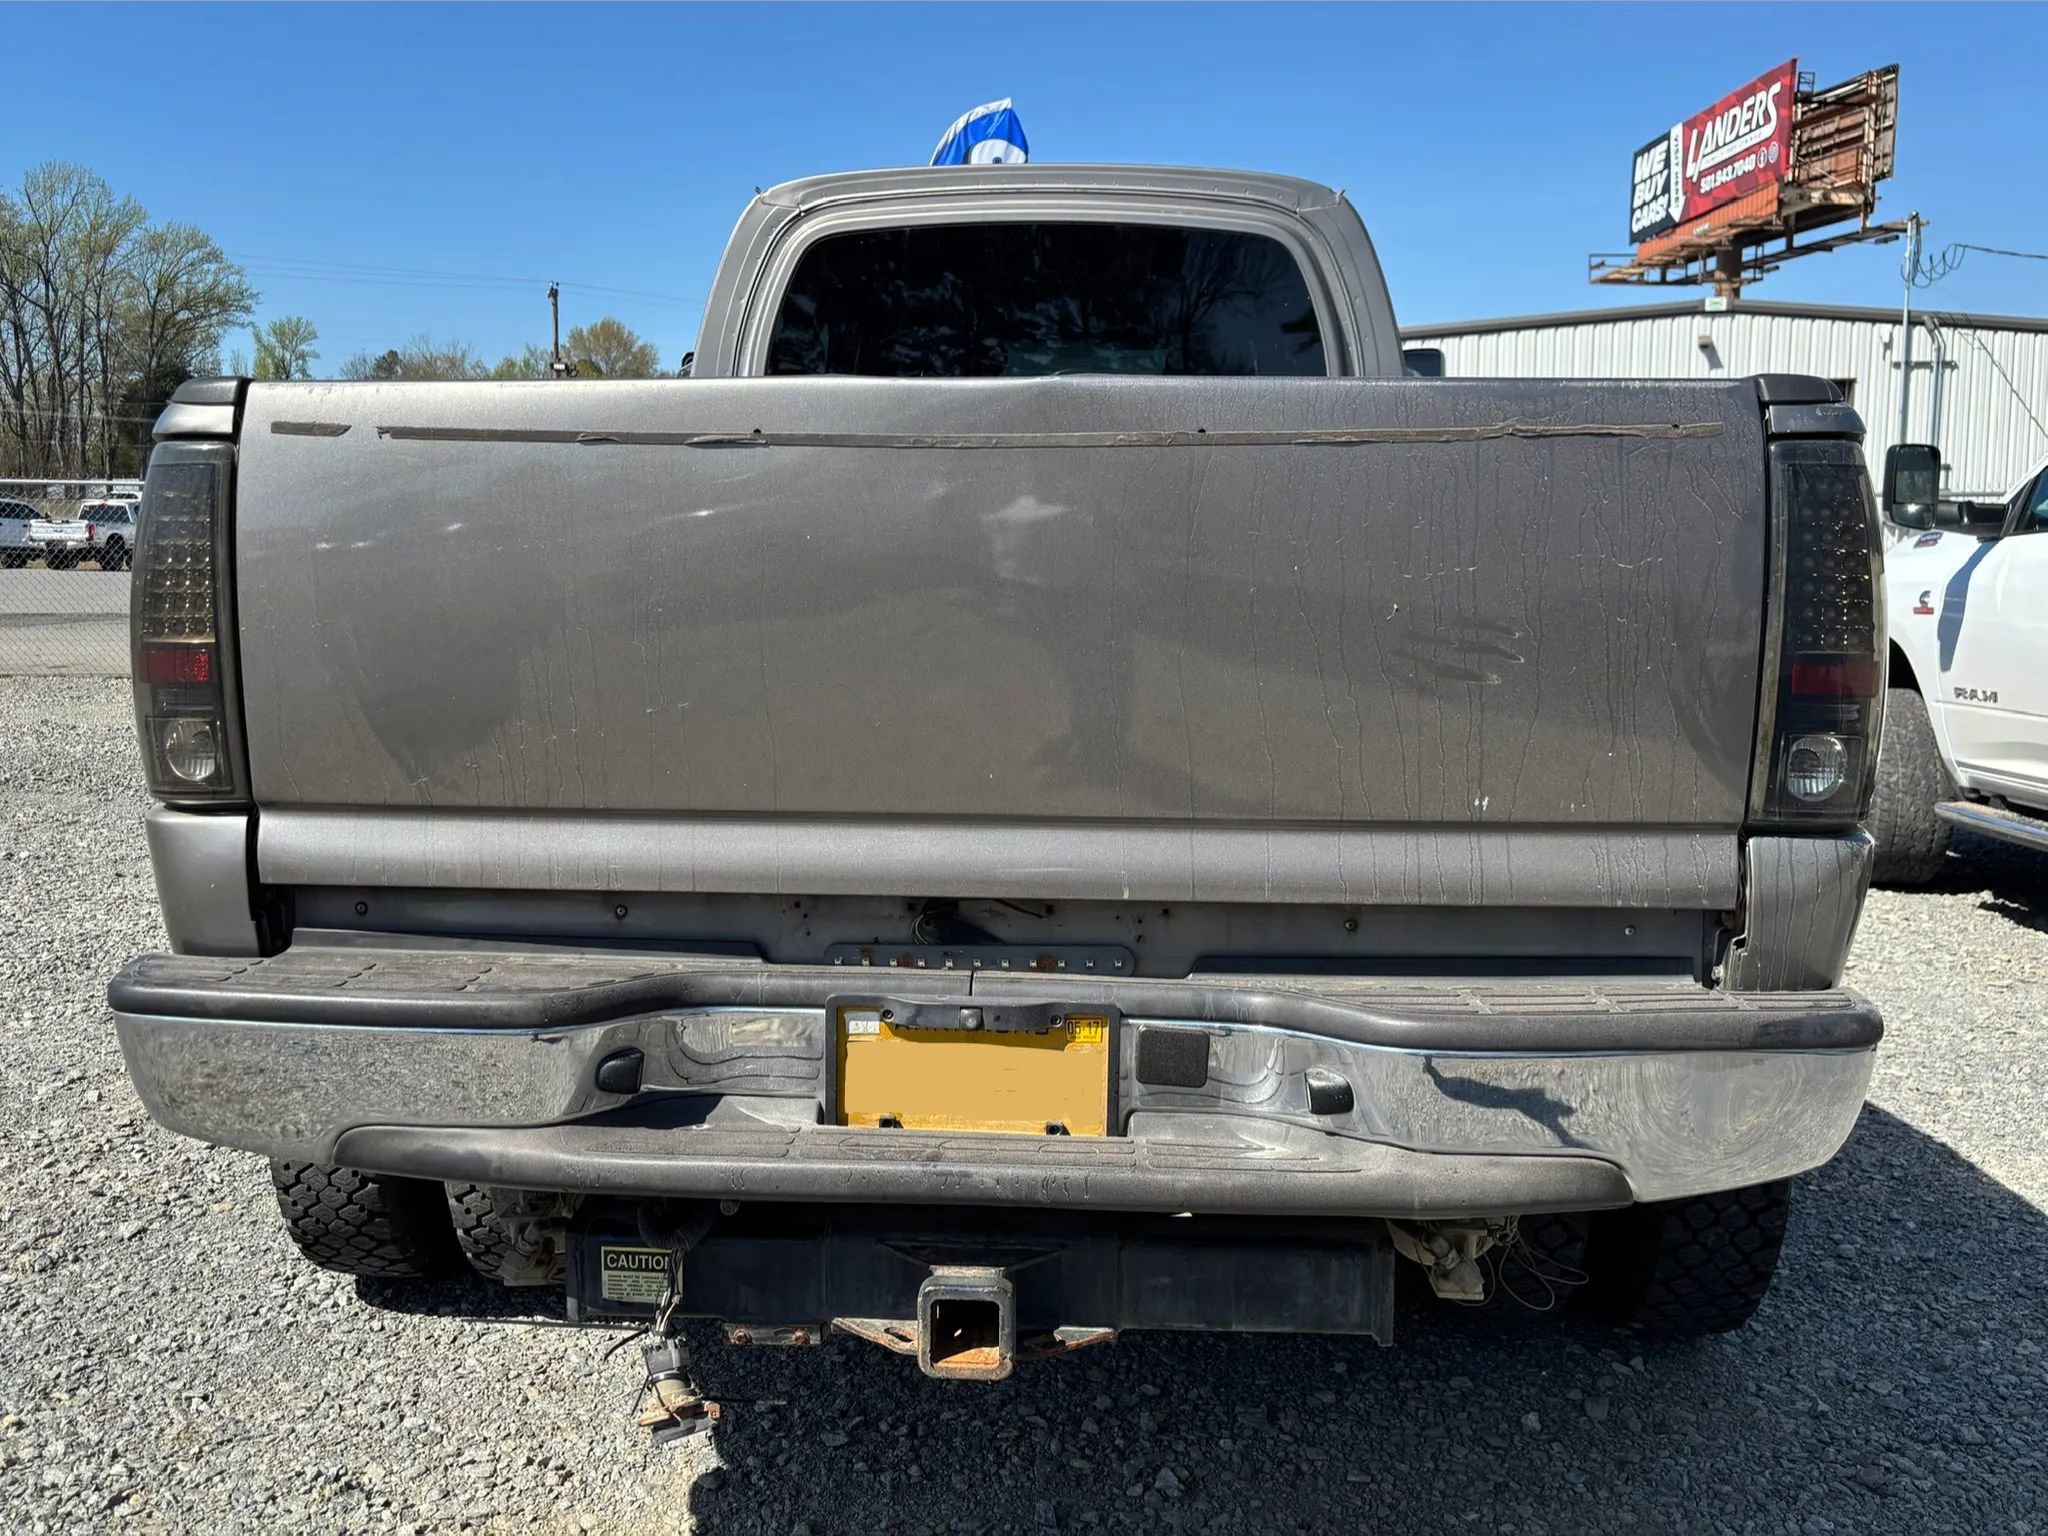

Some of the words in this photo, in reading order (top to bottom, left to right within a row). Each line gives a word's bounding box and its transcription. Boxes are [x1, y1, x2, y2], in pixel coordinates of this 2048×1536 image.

[1686, 81, 1781, 182] LANDERS
[1634, 140, 1669, 184] WE
[1633, 168, 1669, 209] BUY
[1953, 687, 1998, 703] RAM
